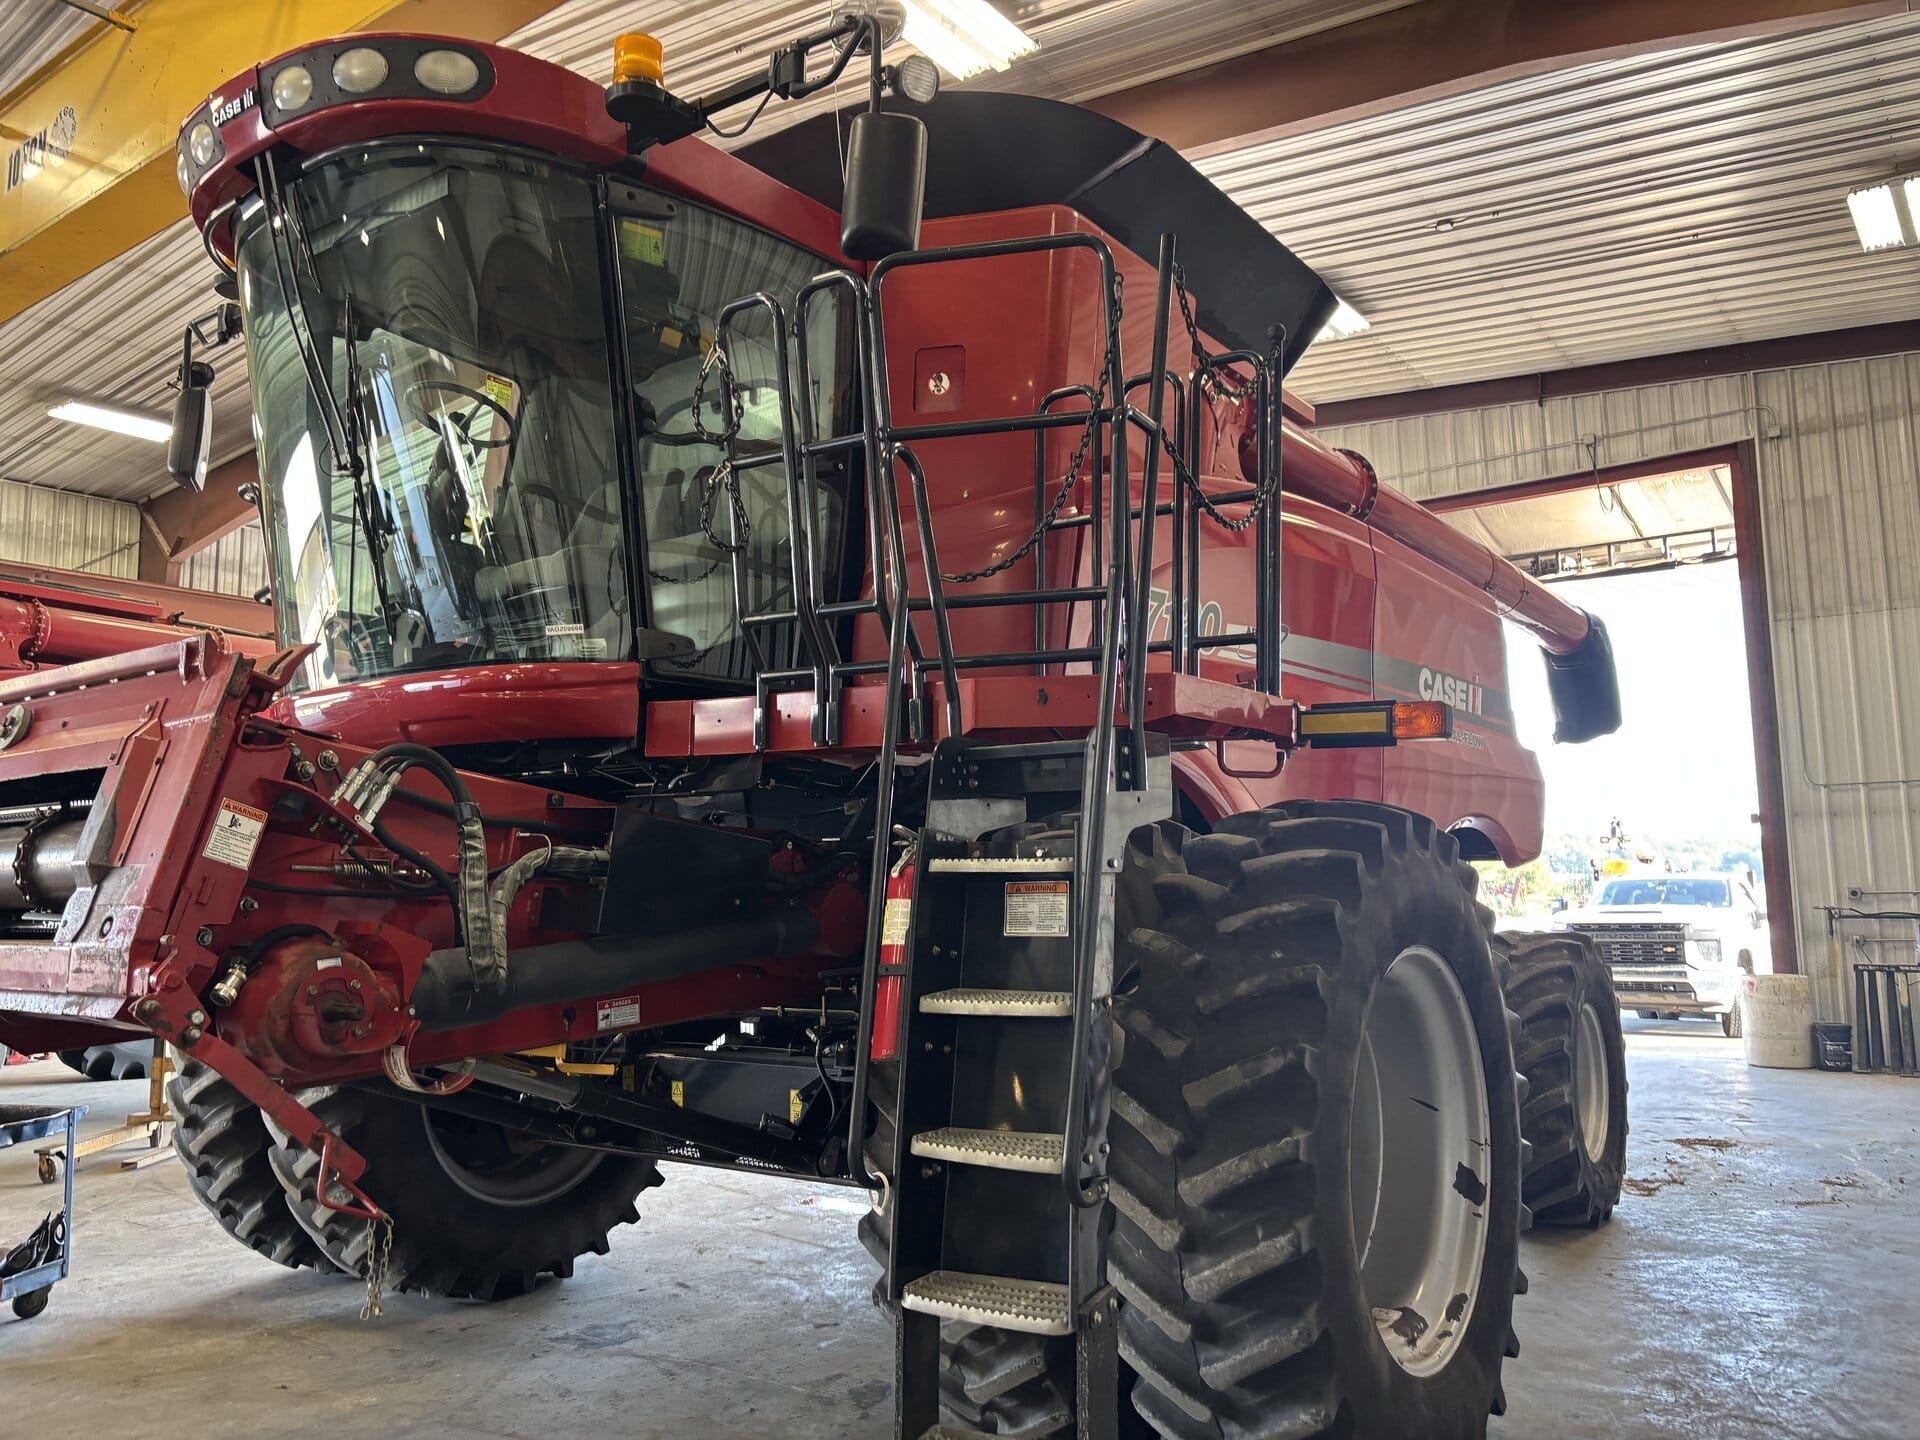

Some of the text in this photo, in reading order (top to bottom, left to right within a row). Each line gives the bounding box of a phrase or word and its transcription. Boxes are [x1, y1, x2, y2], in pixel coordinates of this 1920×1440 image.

[212, 98, 241, 127] CASE
[7, 148, 22, 192] 10
[1148, 587, 1222, 655] 710
[1419, 667, 1467, 711] CASE
[1451, 727, 1484, 749] AL-FLOW
[231, 805, 264, 820] WARNING
[1024, 884, 1057, 892] WARNING
